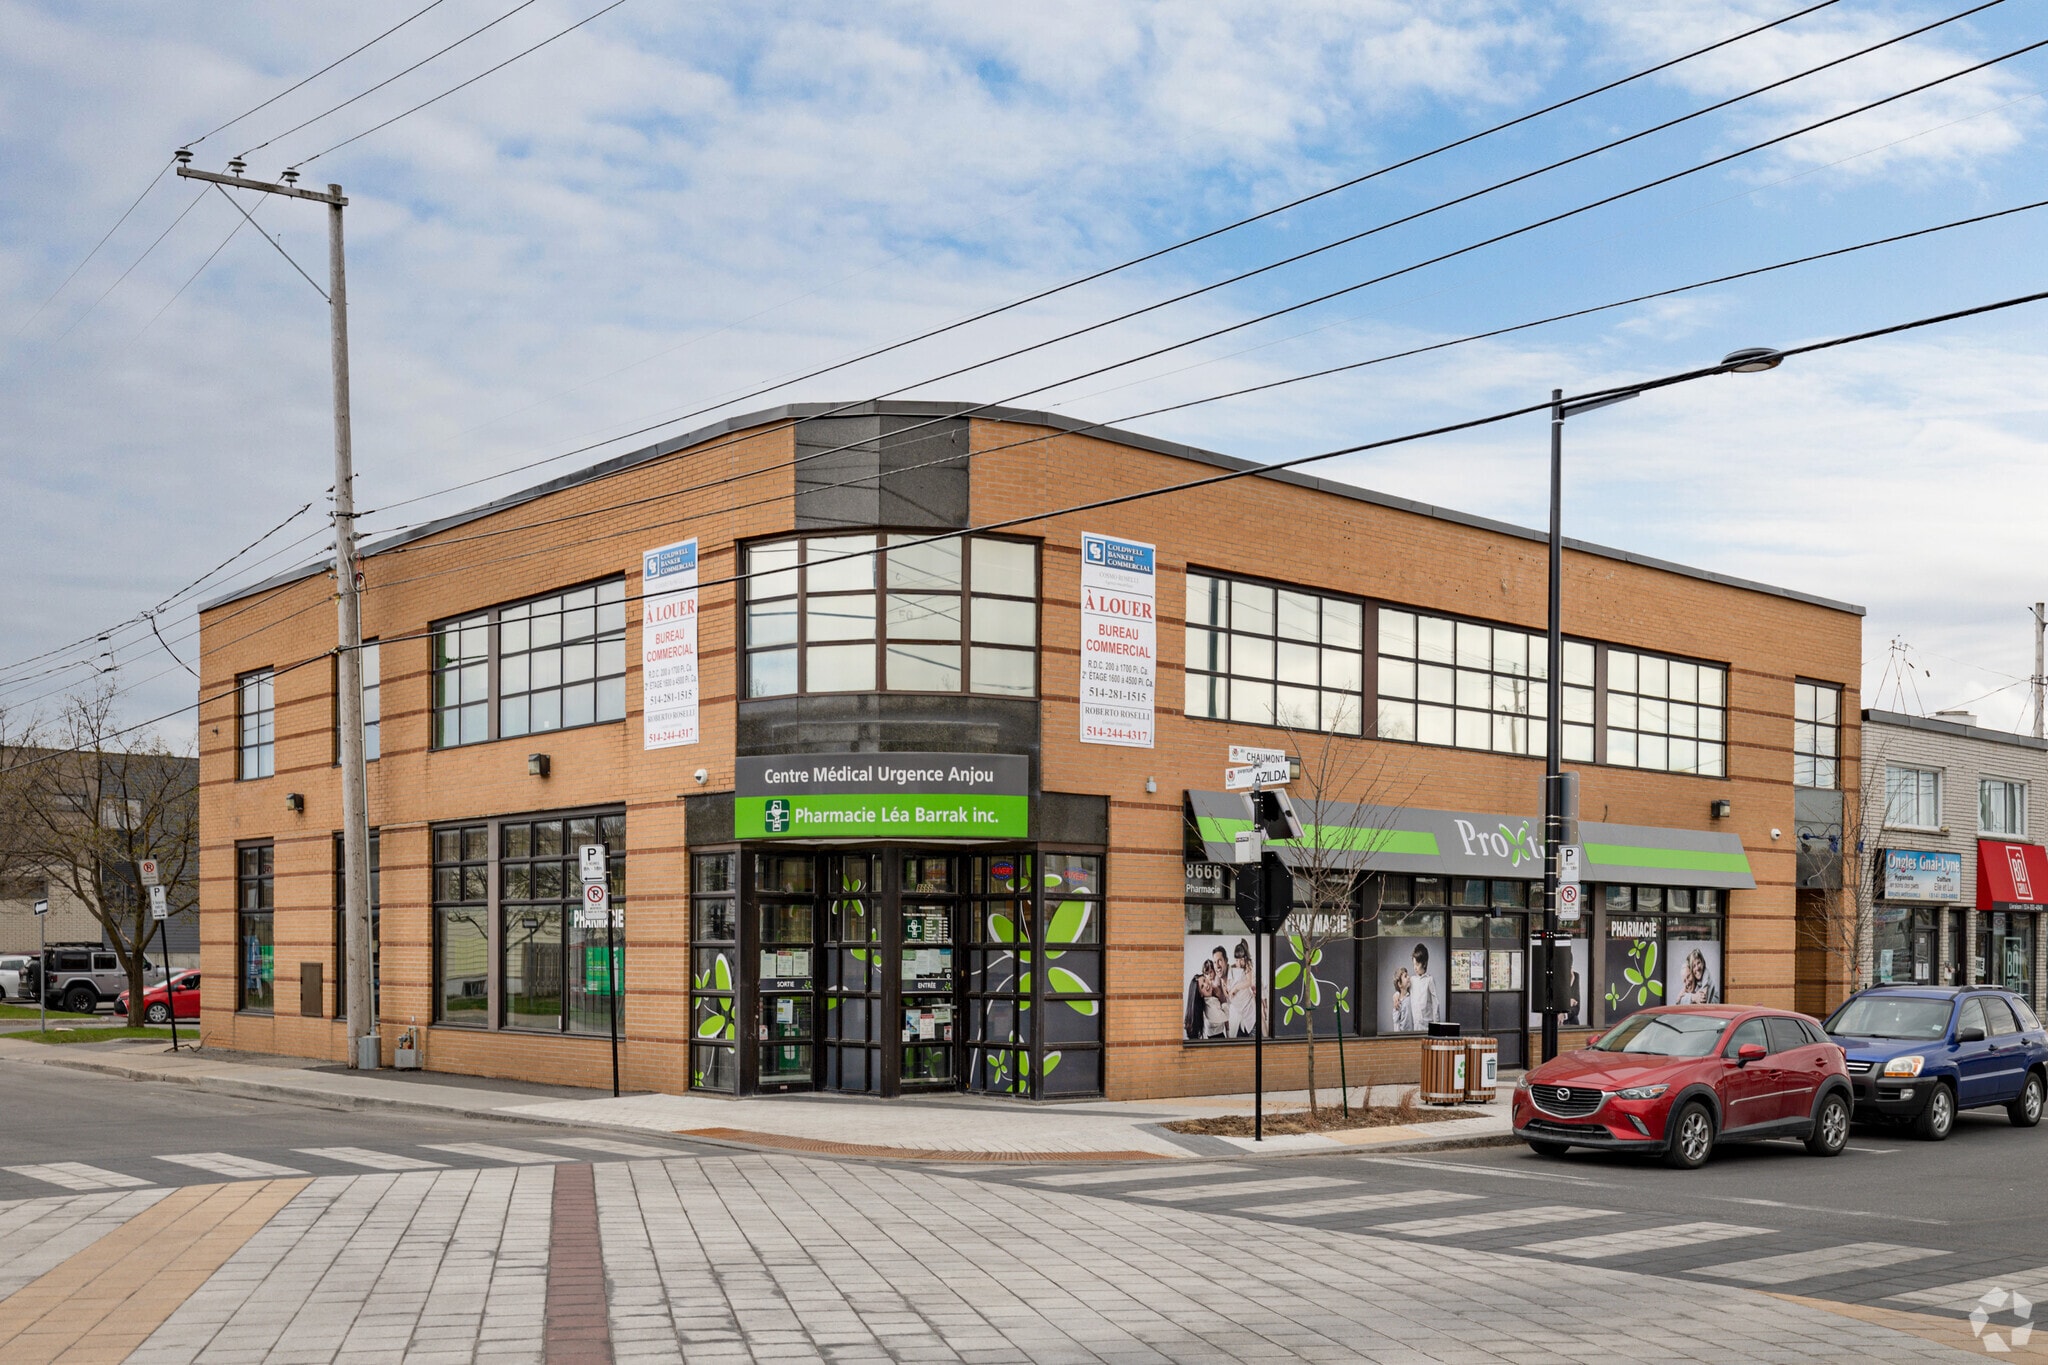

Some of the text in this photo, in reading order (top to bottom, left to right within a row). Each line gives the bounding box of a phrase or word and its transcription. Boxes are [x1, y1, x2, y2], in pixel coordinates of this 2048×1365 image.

[660, 548, 688, 560] COLDWELL
[1107, 544, 1144, 556] COLDWELL
[1107, 552, 1134, 562] BANKER
[660, 557, 680, 568] BANKER
[660, 562, 694, 574] COMMERCIAL
[1107, 558, 1151, 572] COMMERCIAL
[1084, 589, 1152, 618] À LOUER
[646, 599, 694, 624] À LOUER
[656, 628, 684, 644] BUREAU
[1098, 624, 1139, 640] BUREAU
[646, 644, 694, 662] COMMERCIAL
[1086, 638, 1150, 658] COMMERCIAL
[1106, 662, 1114, 670] 200
[1120, 664, 1132, 673] 1700
[1126, 676, 1137, 685] 4500
[650, 690, 692, 705] 514-281-1515
[1089, 687, 1147, 702] 514-281-1515
[648, 708, 695, 722] ROBERTO ROSELLI
[1085, 707, 1150, 720] ROBERTO ROSELLI
[648, 728, 694, 743] 514-244-4317
[1086, 726, 1148, 741] 514-244-4317
[1246, 752, 1284, 763] CHAUMONT
[764, 765, 994, 786] Centre Médical Urgence Anjou
[1254, 770, 1288, 784] AZILDA
[795, 806, 999, 824] Pharmacie Léa Barrak inc.
[588, 848, 596, 862] P
[1566, 850, 1574, 862] P
[992, 866, 1013, 875] OUVERT
[1064, 870, 1088, 880] OUVERT
[1186, 864, 1221, 880] 8666
[154, 888, 160, 896] P
[1186, 884, 1221, 894] Pharmacie
[1612, 920, 1656, 938] PHARMACIE
